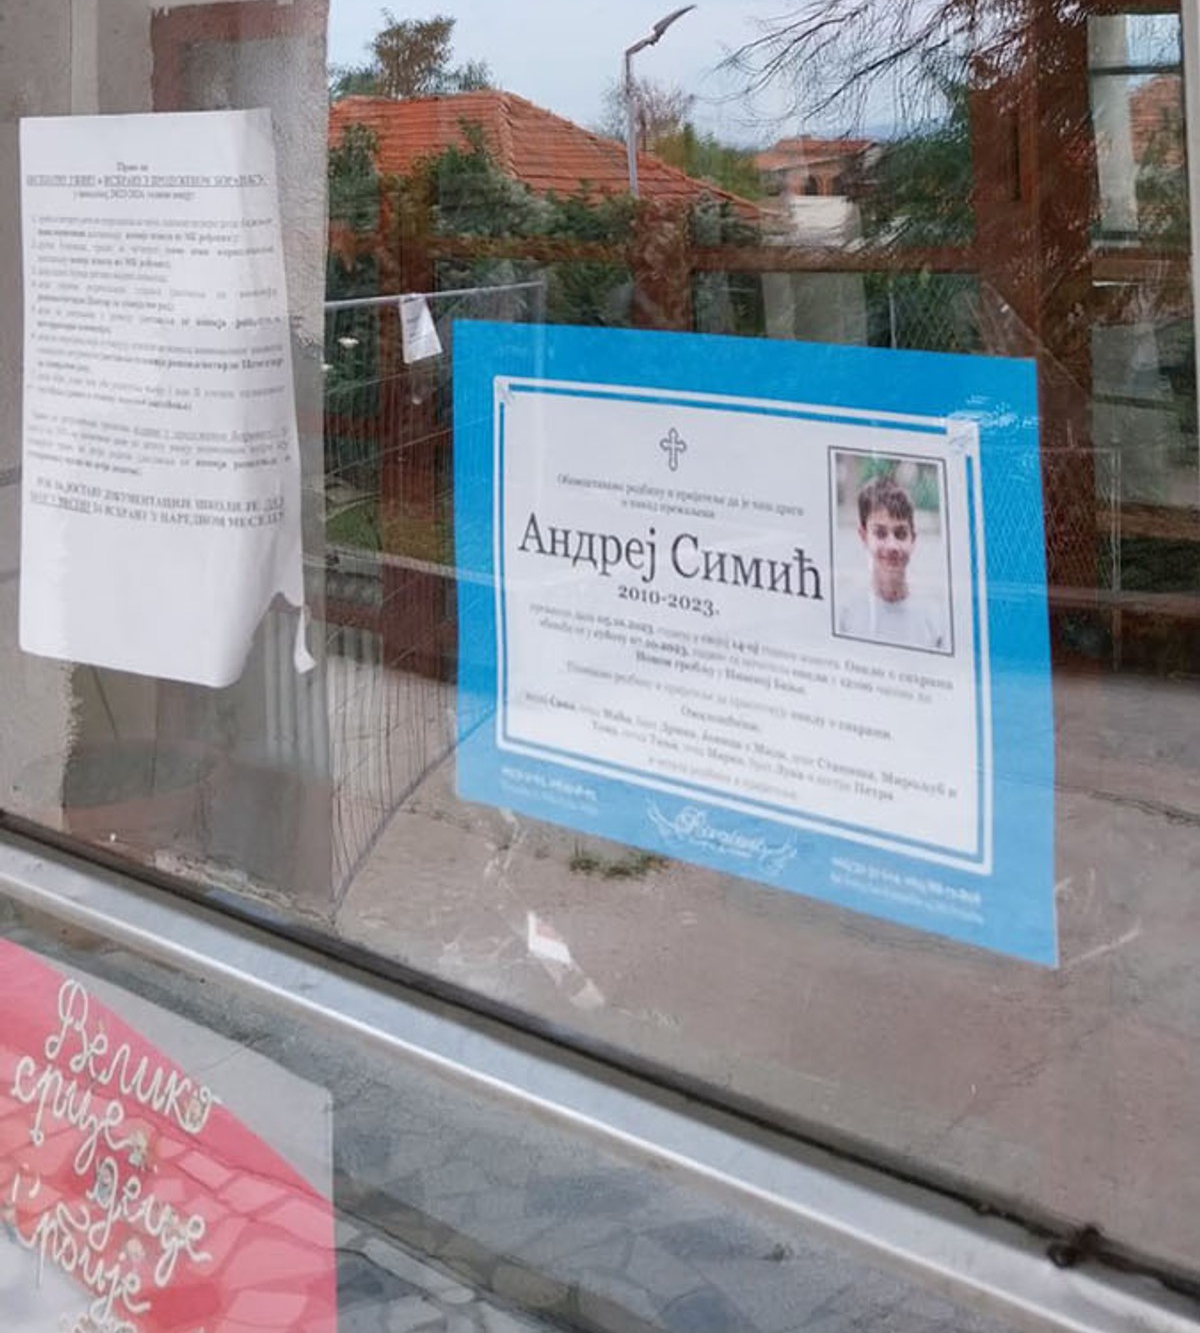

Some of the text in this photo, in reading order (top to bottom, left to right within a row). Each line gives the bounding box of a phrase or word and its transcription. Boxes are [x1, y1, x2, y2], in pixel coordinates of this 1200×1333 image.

[518, 512, 824, 600] Андреј Симић
[618, 584, 720, 617] 2010-2023.
